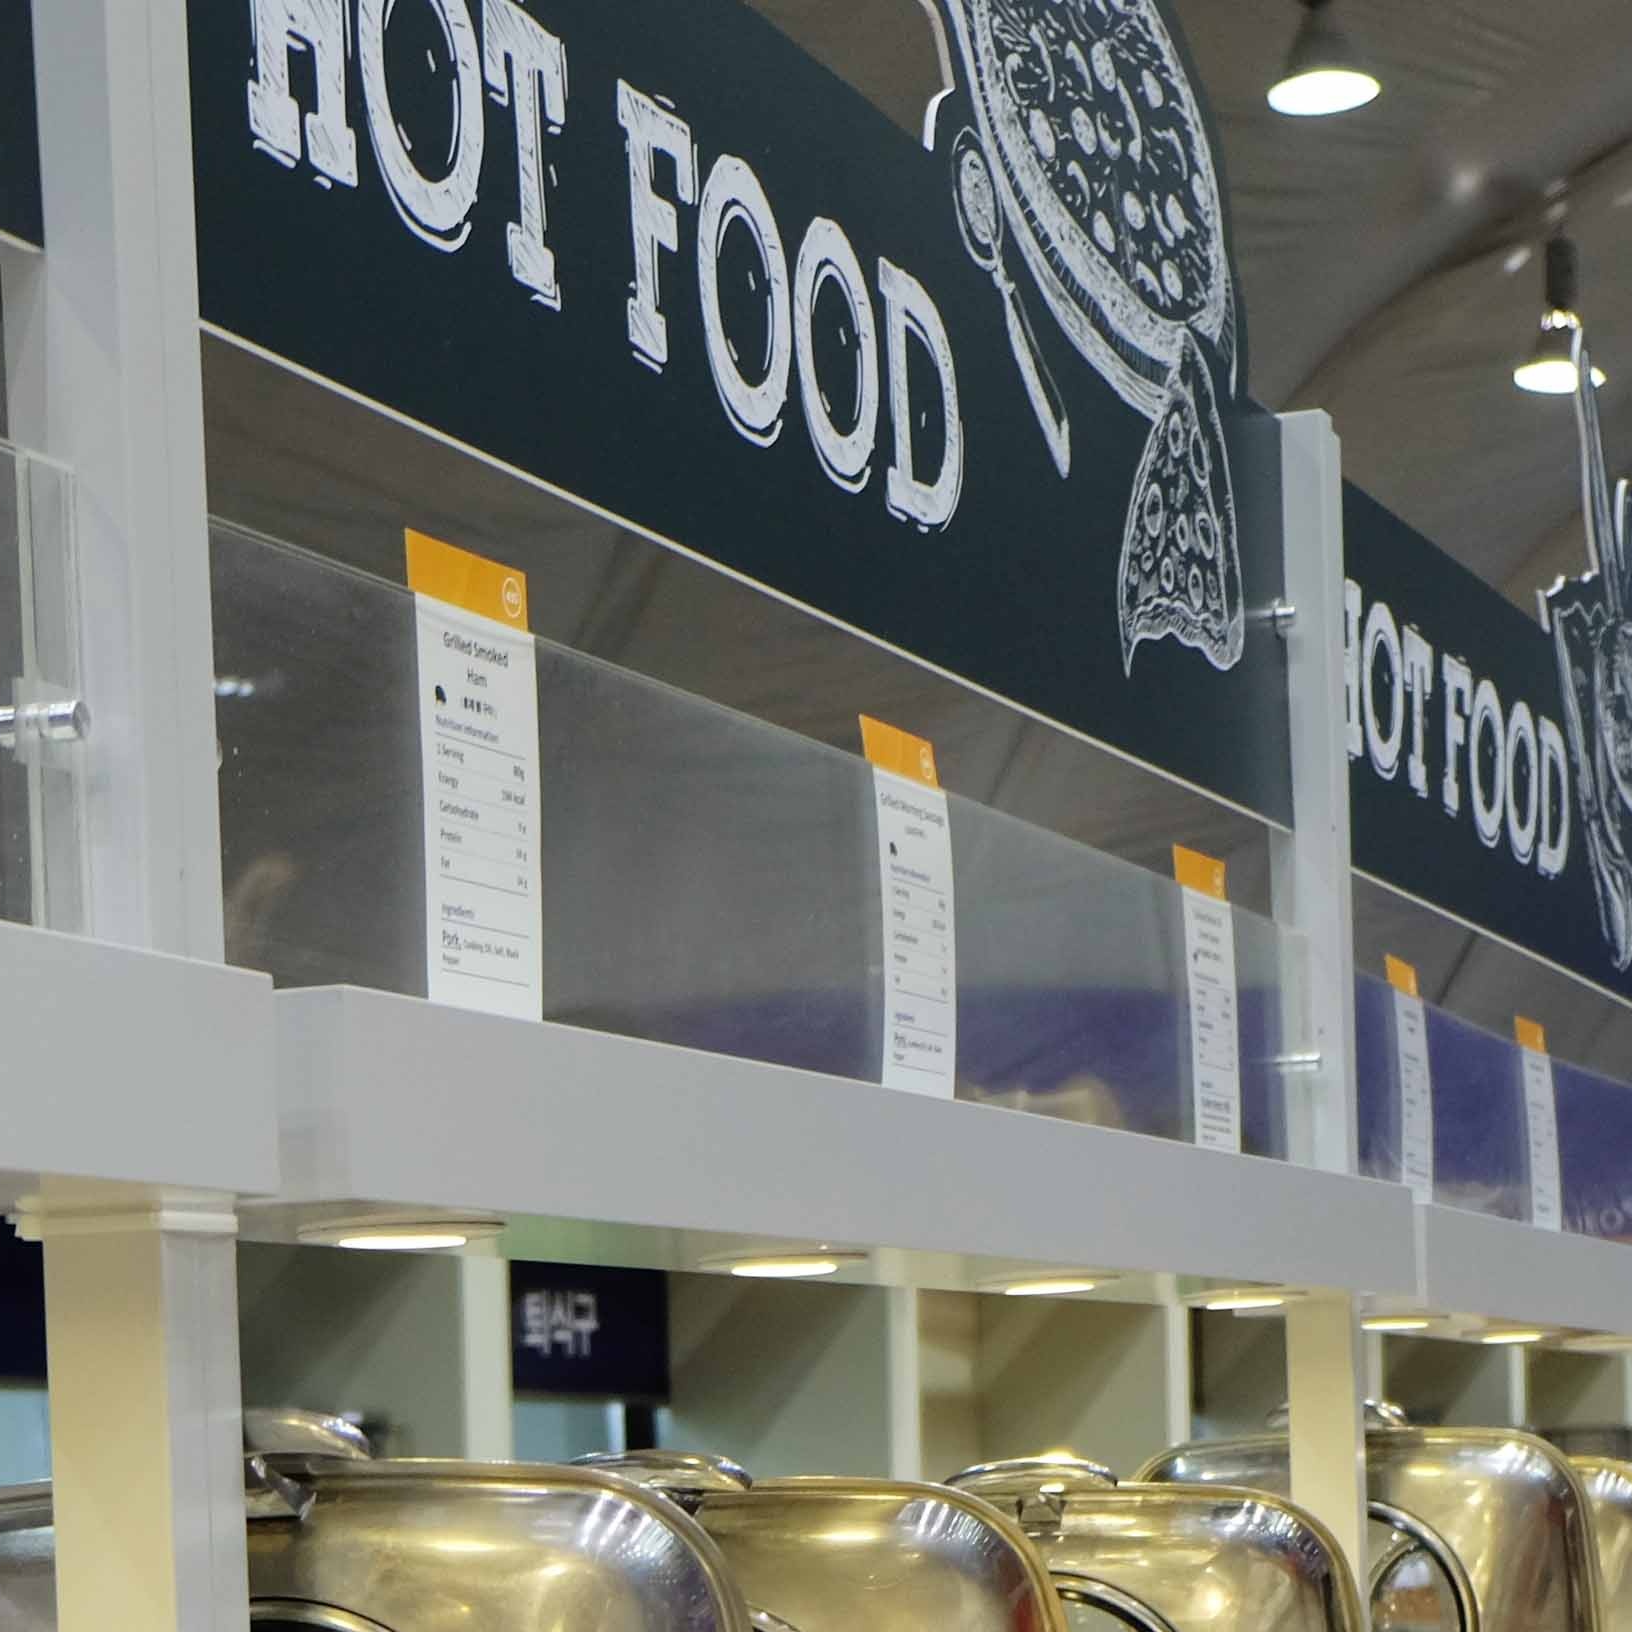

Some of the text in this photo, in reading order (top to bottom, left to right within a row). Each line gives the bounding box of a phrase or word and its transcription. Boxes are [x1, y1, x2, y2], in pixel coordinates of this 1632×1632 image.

[615, 78, 965, 535] FOOD
[443, 632, 510, 669] Grilled Smoked
[466, 667, 488, 688] Ham
[1441, 653, 1569, 880] FOOD
